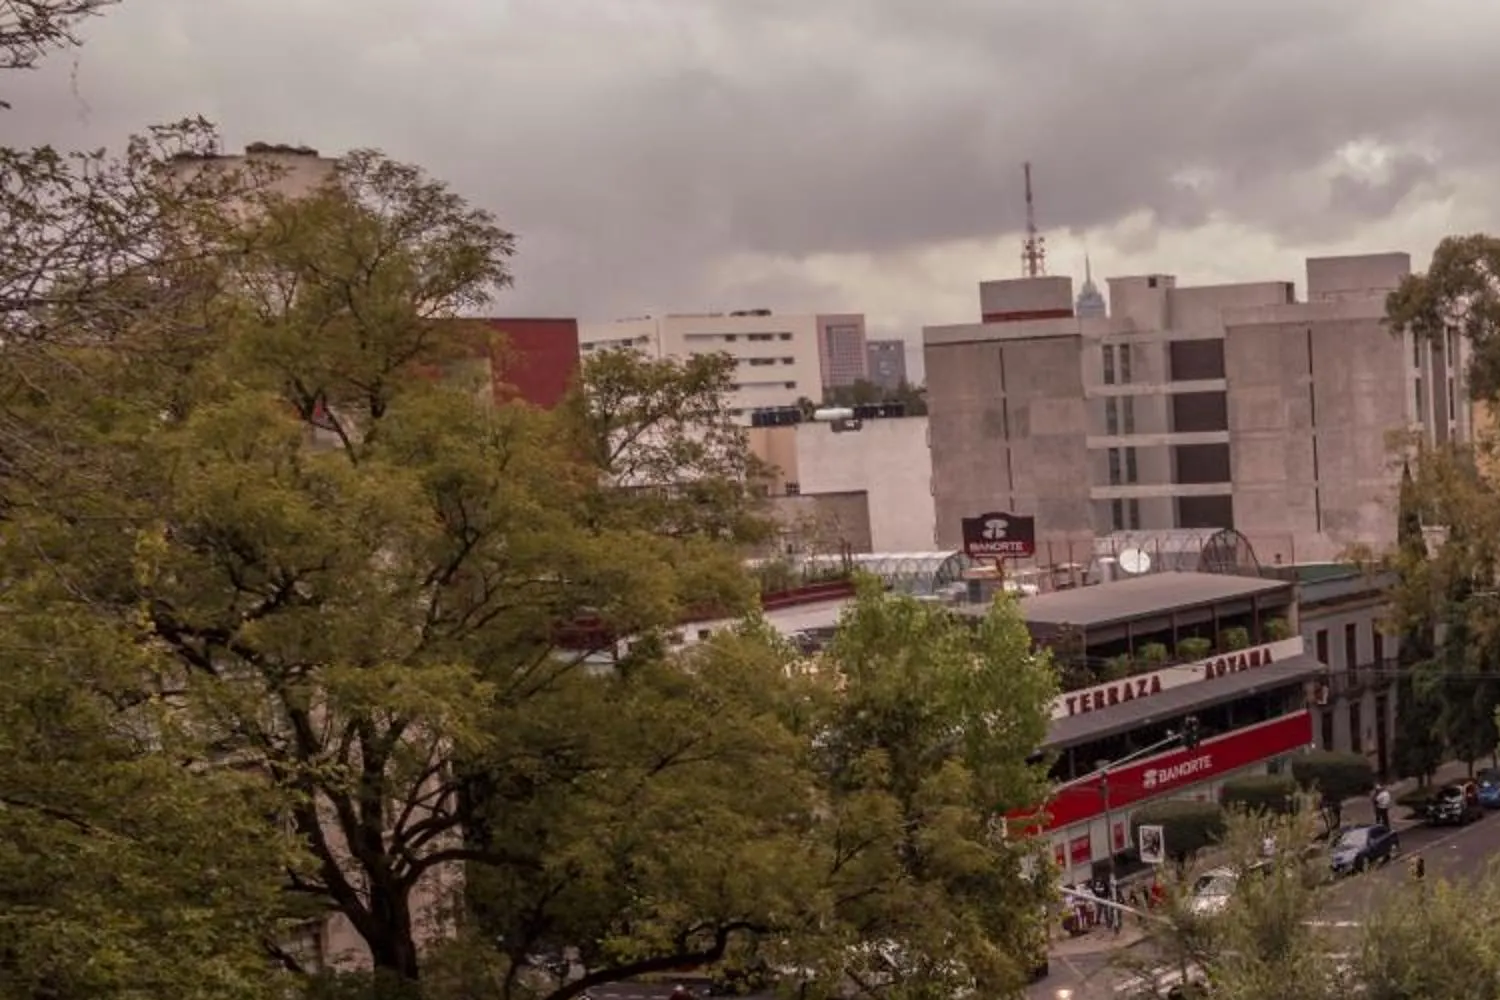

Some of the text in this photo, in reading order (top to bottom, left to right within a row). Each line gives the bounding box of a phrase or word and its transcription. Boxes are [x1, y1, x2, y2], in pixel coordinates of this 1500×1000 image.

[969, 541, 1024, 552] BANORTE
[1066, 648, 1273, 716] TERRAZA AOYAMA
[1159, 755, 1213, 783] BANORTE
